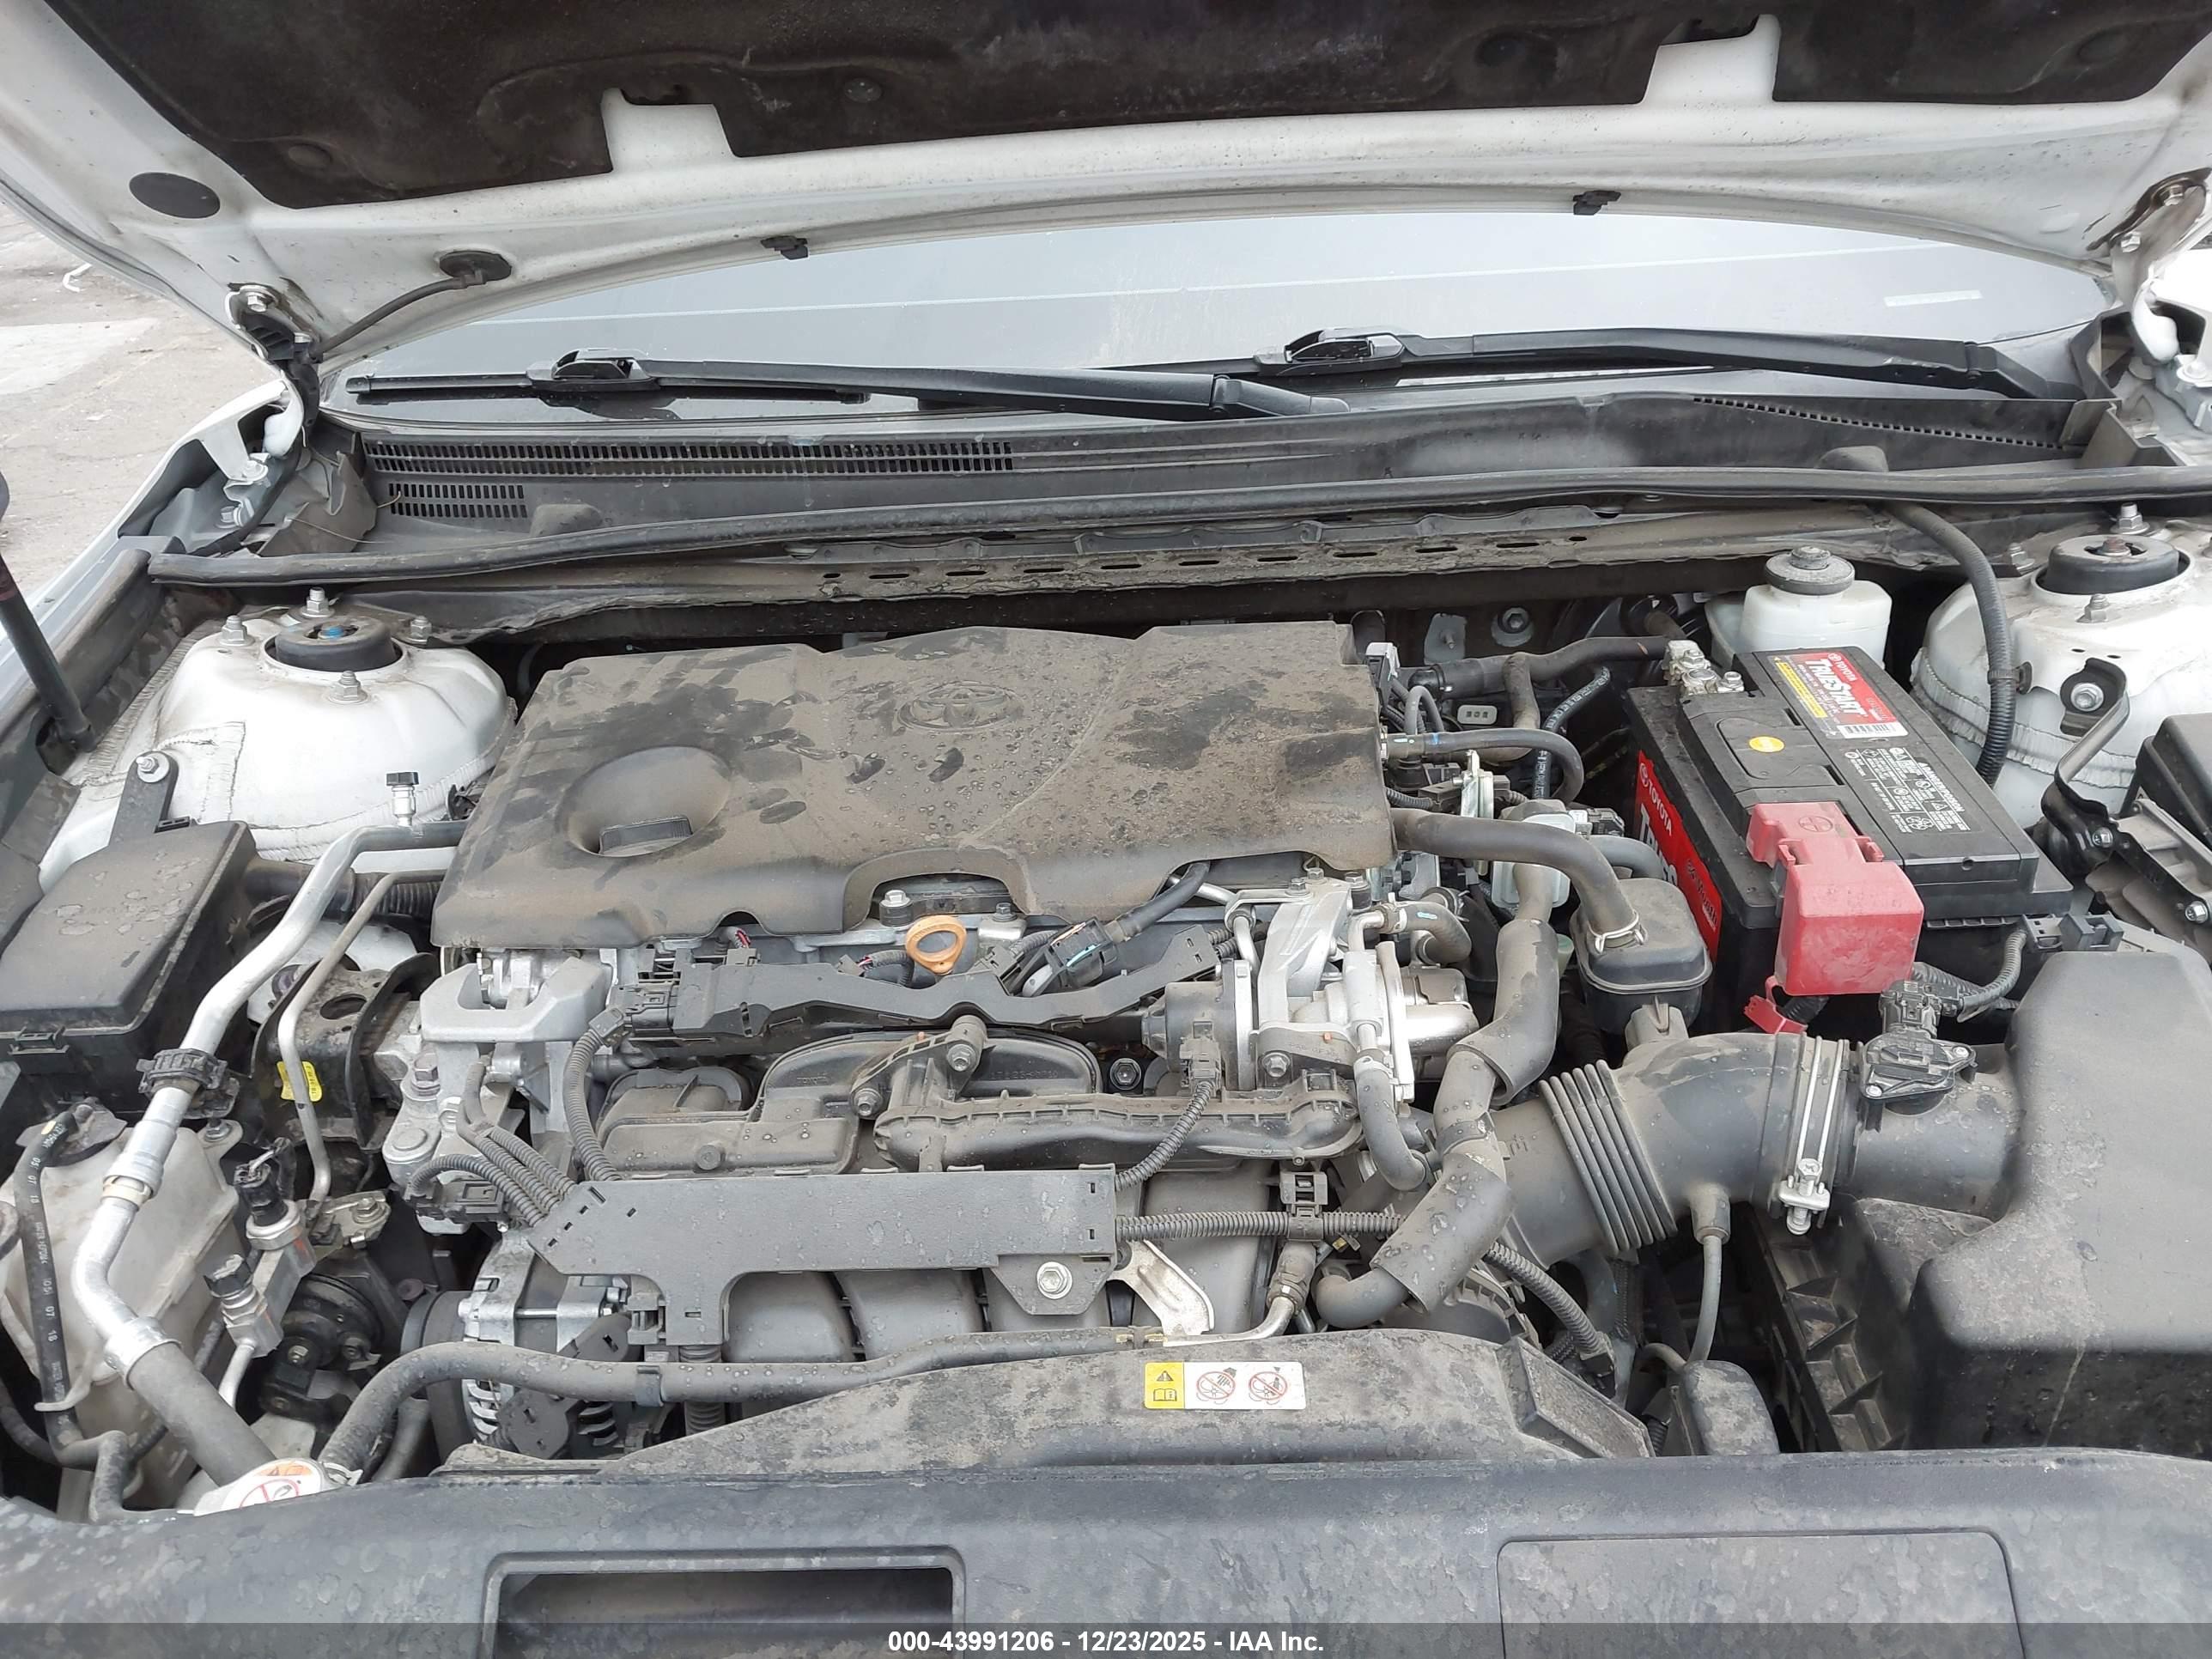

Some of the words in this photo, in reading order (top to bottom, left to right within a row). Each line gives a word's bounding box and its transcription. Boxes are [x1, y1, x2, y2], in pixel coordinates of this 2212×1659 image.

[1835, 660, 1857, 681] TOYOTA
[1805, 659, 1867, 717] TRUESTART
[1648, 781, 1672, 836] TOYOTA
[46, 1306, 55, 1316] 07
[48, 1330, 58, 1342] 18
